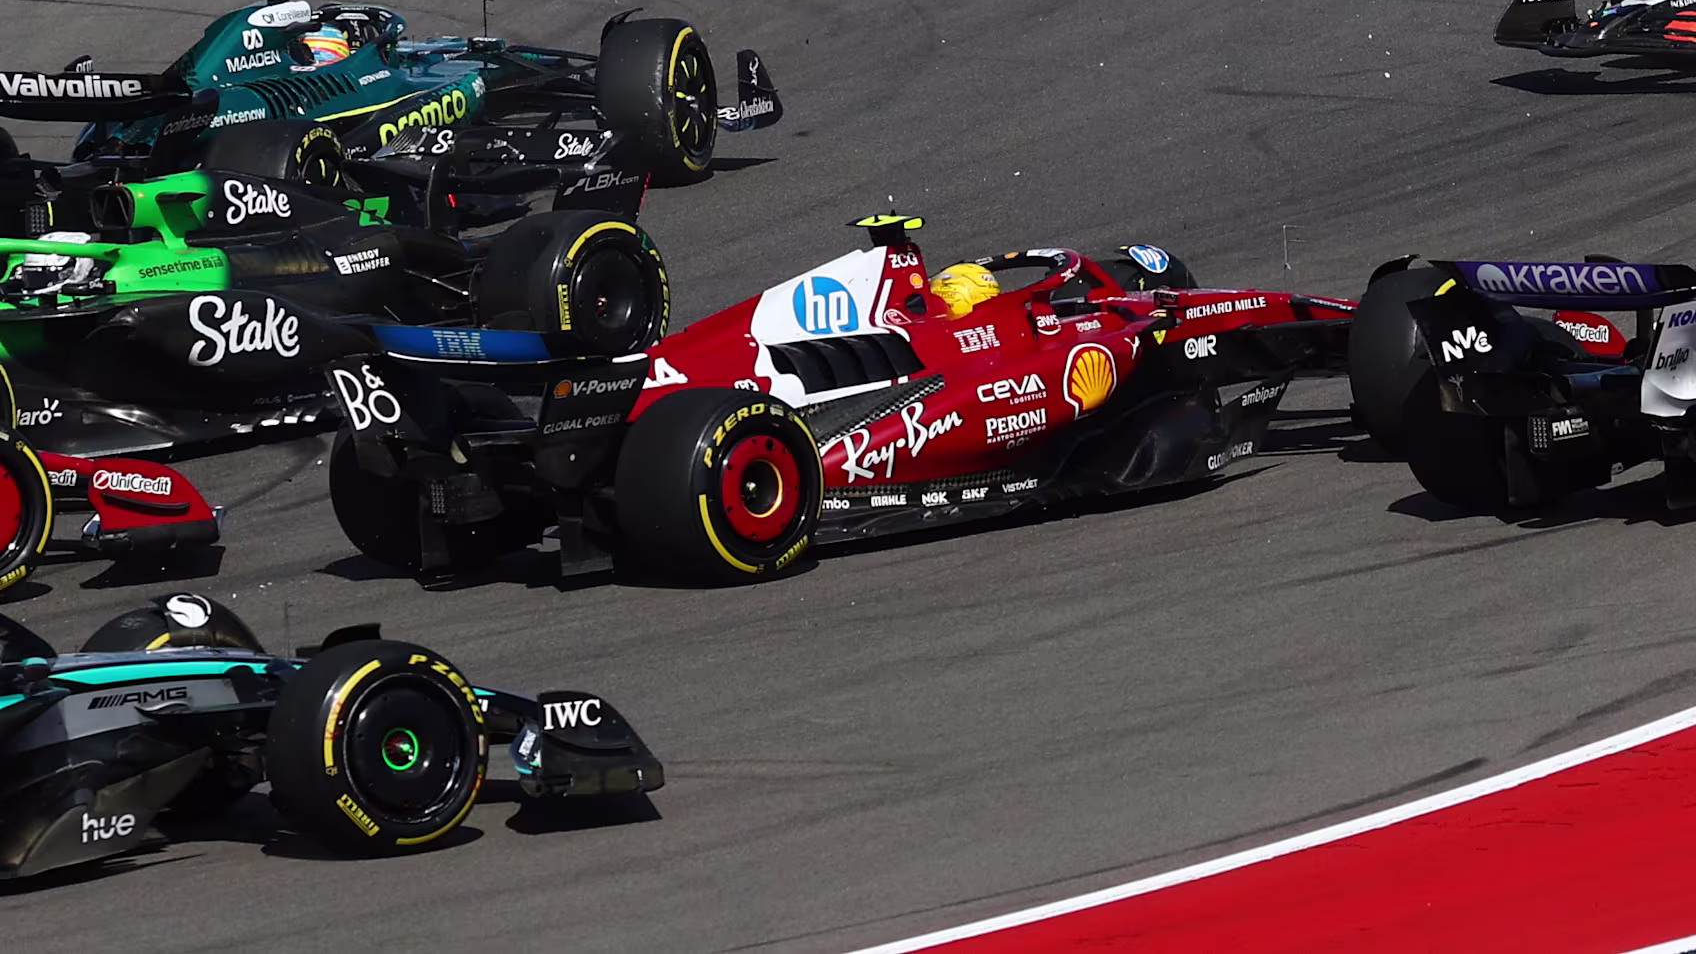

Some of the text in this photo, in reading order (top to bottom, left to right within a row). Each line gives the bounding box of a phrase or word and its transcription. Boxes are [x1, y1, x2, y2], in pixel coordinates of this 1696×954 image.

[225, 49, 282, 74] MAADEN
[0, 73, 142, 98] Valvoline
[209, 106, 266, 129] servicenow
[302, 127, 332, 149] ZERO
[223, 179, 292, 224] Stake
[348, 248, 381, 262] ENERGY
[350, 256, 391, 275] TRANSFER
[138, 258, 202, 280] sensetime
[1511, 264, 1648, 295] kraken
[803, 277, 850, 334] hp
[1186, 296, 1267, 320] RICHARD MILLE
[188, 295, 300, 366] Stake
[1036, 314, 1060, 328] aws
[433, 330, 487, 358] IBM
[954, 325, 1000, 353] IBM
[572, 376, 637, 396] V-Power
[1241, 384, 1283, 407] ambipar
[1009, 391, 1047, 405] LOGISTICS
[15, 407, 54, 426] laro
[543, 412, 622, 435] GLOBAL POKER
[712, 402, 766, 445] ZERO
[985, 407, 1047, 437] PERONI
[110, 472, 172, 495] UniCredit
[961, 487, 989, 500] SKF
[870, 494, 907, 507] MAHLE
[921, 491, 948, 507] NGK
[120, 686, 187, 706] AMG
[408, 653, 484, 725] P ZERO
[543, 698, 602, 732] IWC
[82, 812, 136, 844] hue
